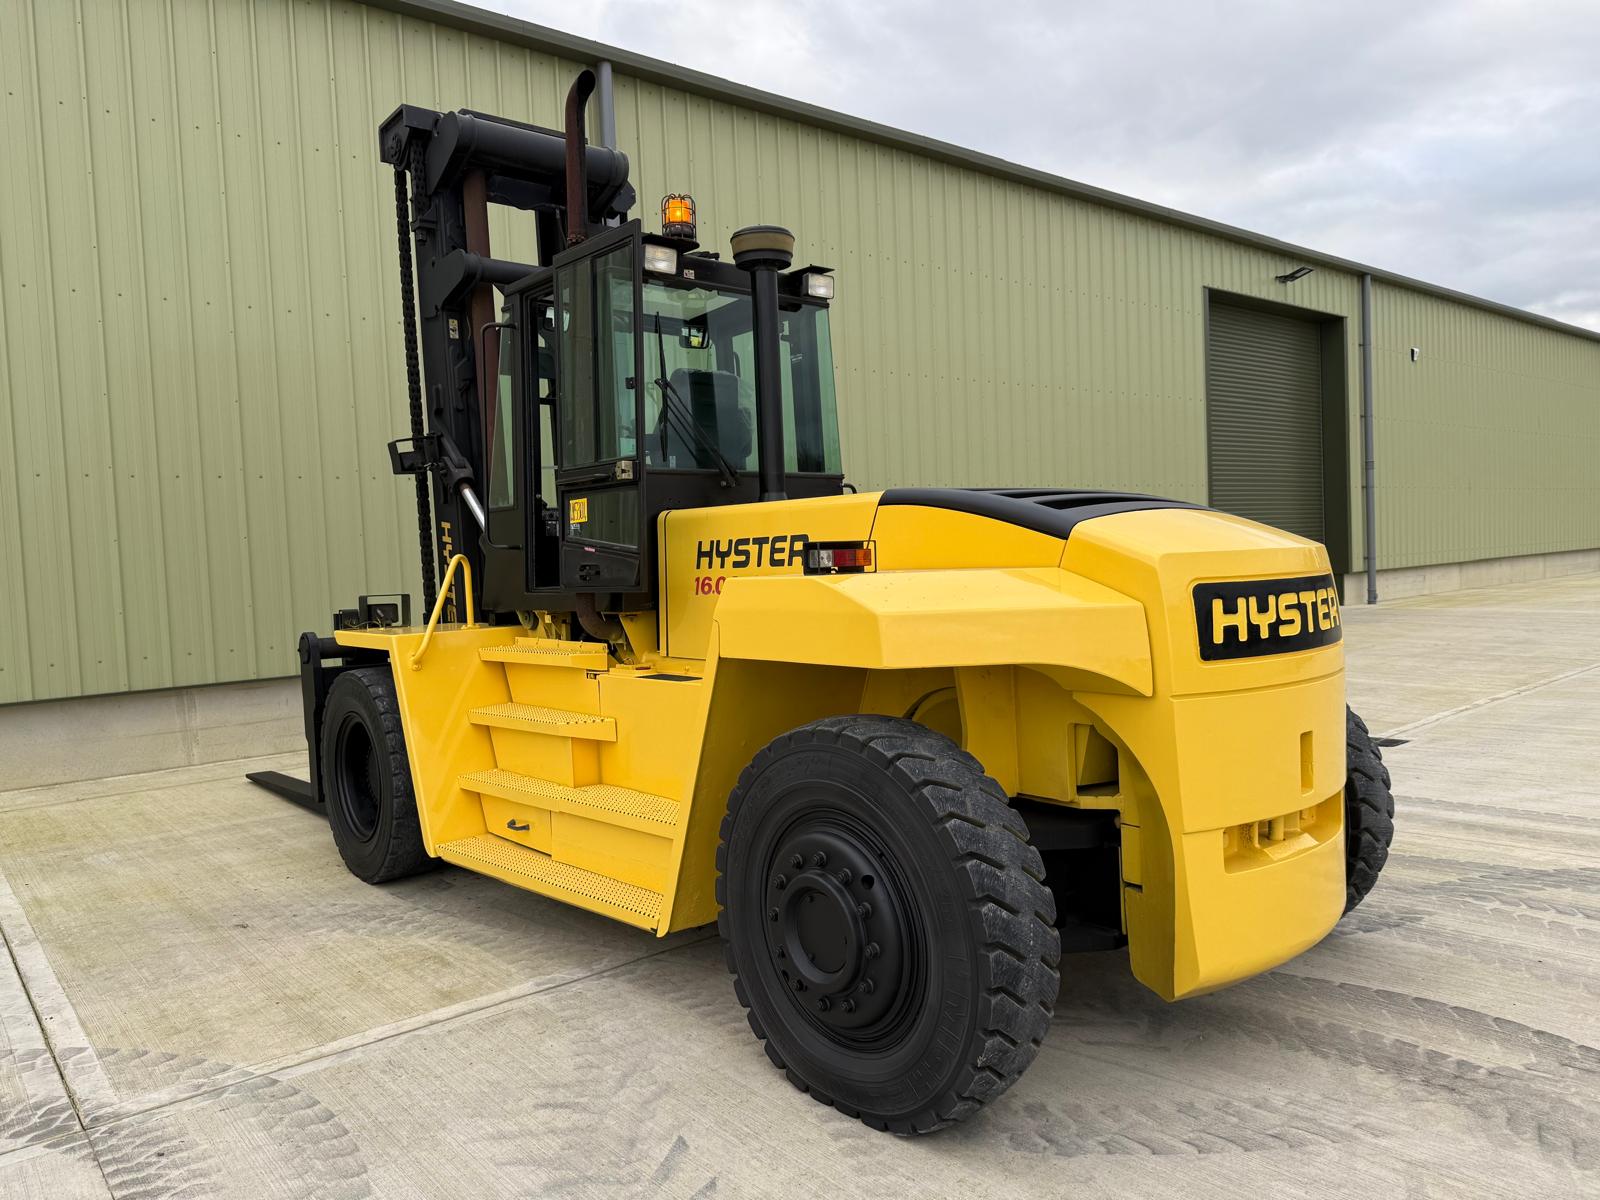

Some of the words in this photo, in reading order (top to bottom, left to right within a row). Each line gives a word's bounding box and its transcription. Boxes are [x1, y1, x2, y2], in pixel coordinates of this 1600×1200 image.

[696, 534, 809, 569] HYSTER
[695, 576, 727, 596] 16.0
[1212, 587, 1339, 644] HYSTER
